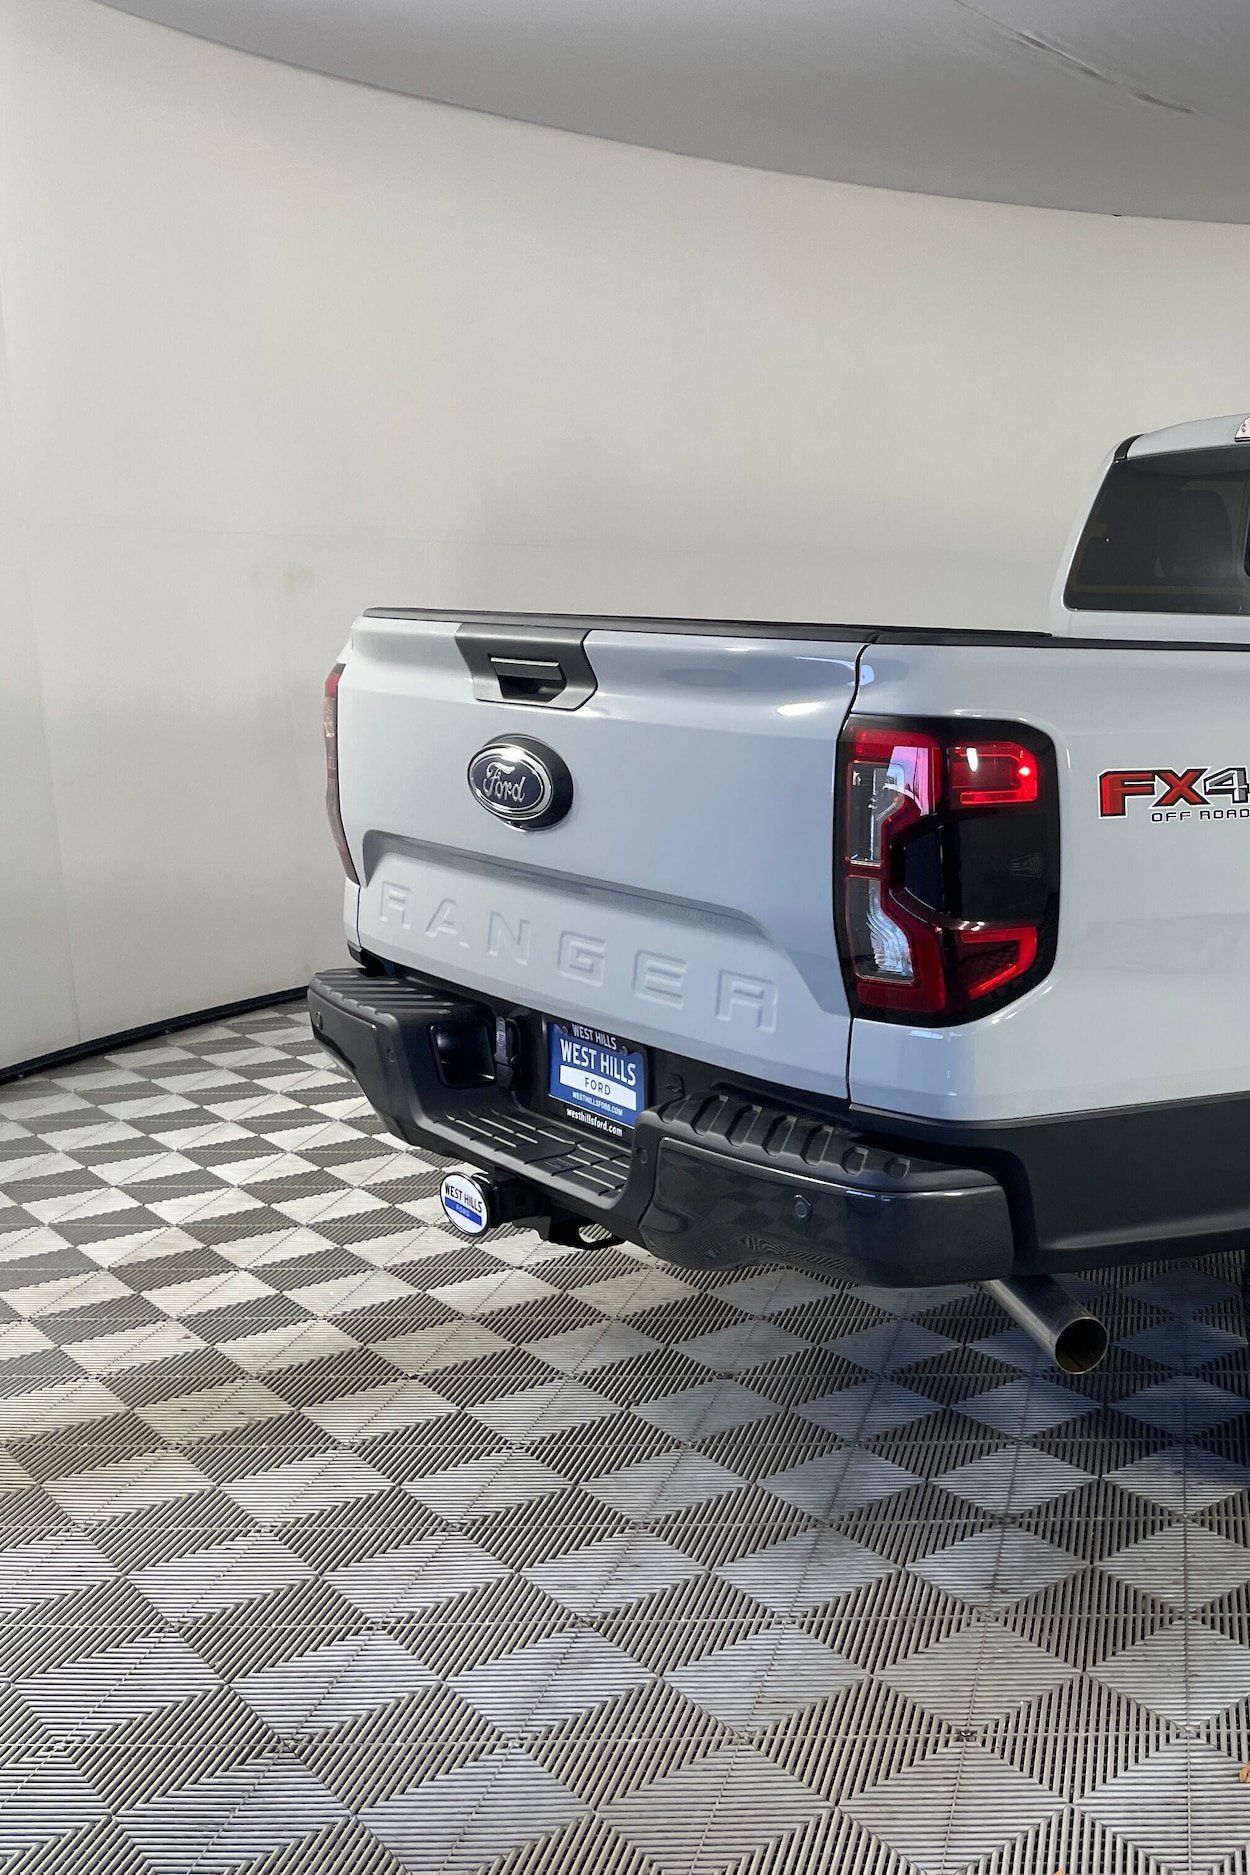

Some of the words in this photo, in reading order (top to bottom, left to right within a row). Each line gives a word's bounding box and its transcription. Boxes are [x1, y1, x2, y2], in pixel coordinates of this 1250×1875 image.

[483, 761, 526, 803] Ford
[1097, 765, 1250, 819] FX4
[1150, 810, 1192, 823] OFF
[1199, 808, 1250, 820] ROAD
[379, 880, 780, 1033] RANGER
[571, 1023, 594, 1041] WEST
[595, 1030, 617, 1051] HILLS
[559, 1038, 598, 1070] WEST
[600, 1052, 637, 1087] HILLS
[584, 1076, 611, 1096] FORD
[571, 1090, 624, 1117] WESTHILLSFORD.COM
[566, 1107, 624, 1138] westhillsford.com
[445, 1181, 463, 1201] WEST
[464, 1193, 482, 1213] HILLS
